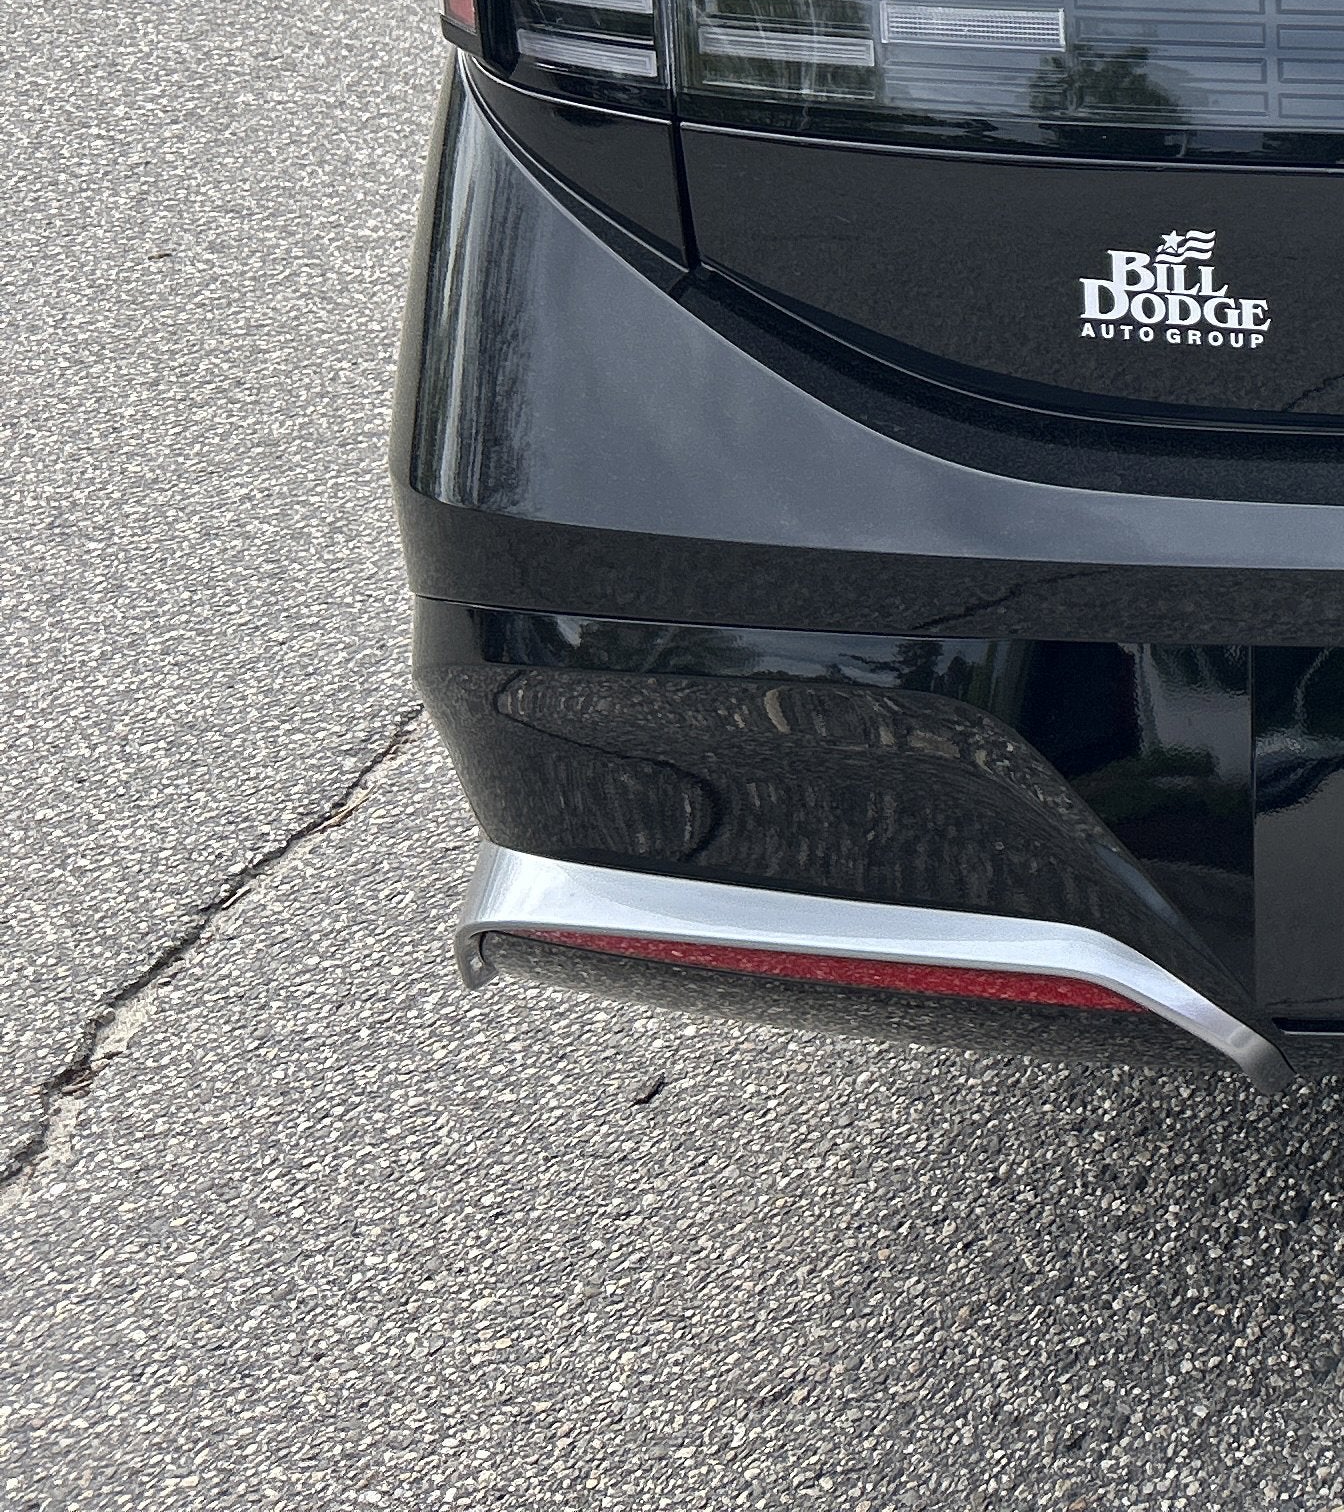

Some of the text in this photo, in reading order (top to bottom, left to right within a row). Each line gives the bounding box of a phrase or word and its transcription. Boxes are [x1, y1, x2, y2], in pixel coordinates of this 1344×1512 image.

[1106, 249, 1229, 297] BILL
[1079, 278, 1272, 331] DODGE
[1081, 322, 1265, 349] AUTO GROUP
